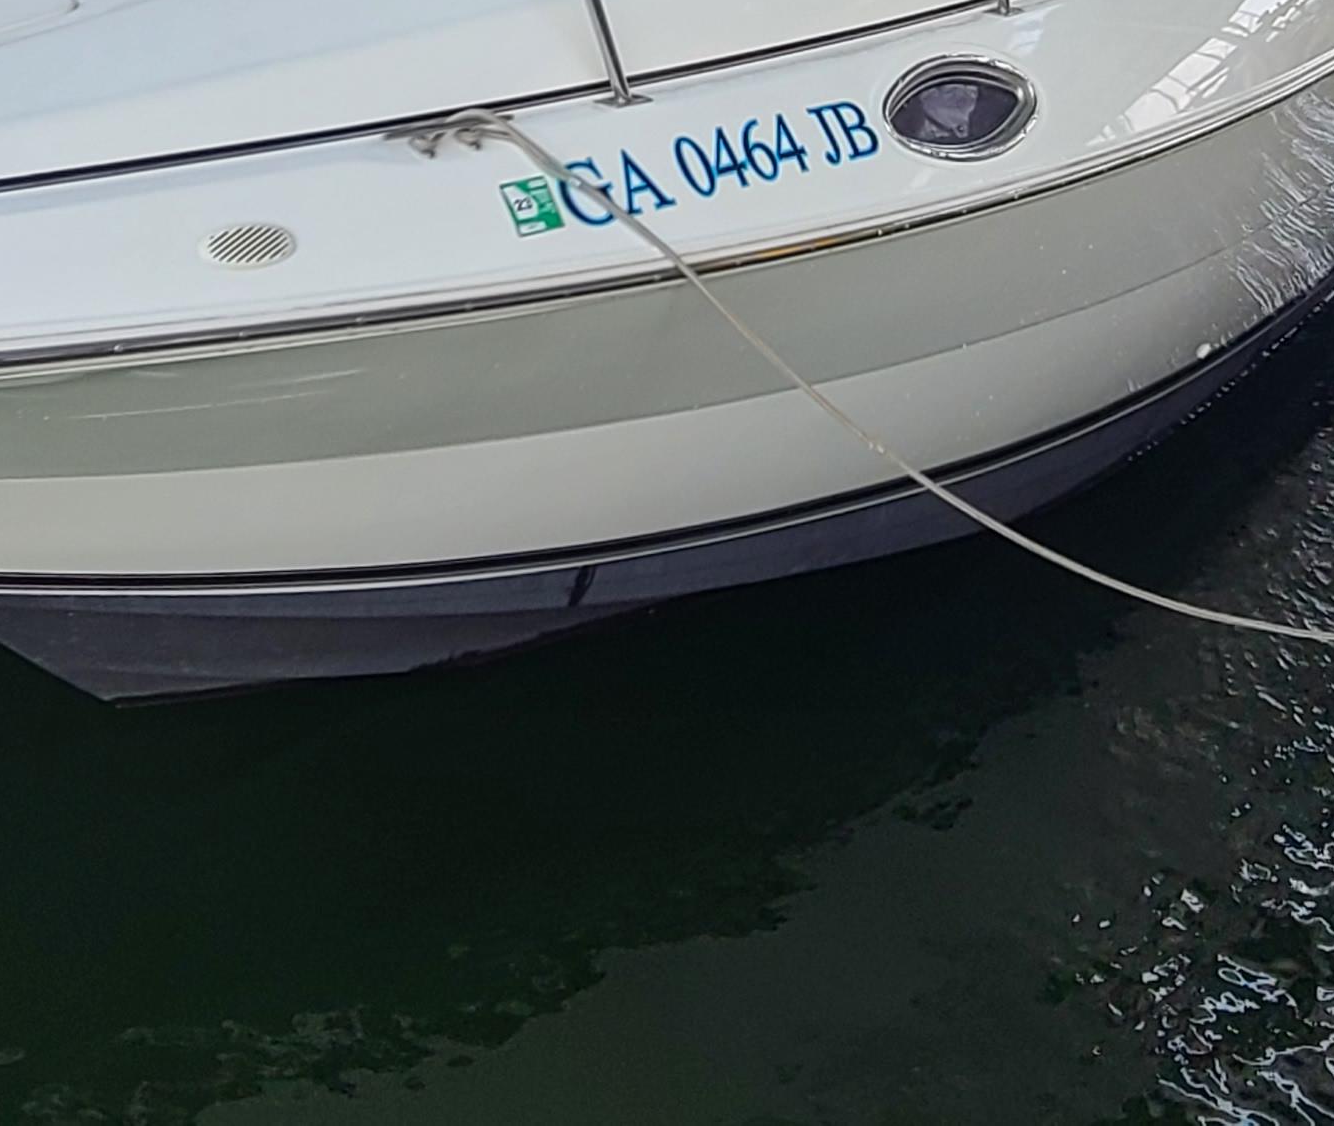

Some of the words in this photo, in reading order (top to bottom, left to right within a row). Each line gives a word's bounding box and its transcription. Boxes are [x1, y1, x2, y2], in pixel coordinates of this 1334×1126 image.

[560, 149, 676, 226] GA
[674, 111, 809, 197] 0464
[806, 101, 879, 166] JB
